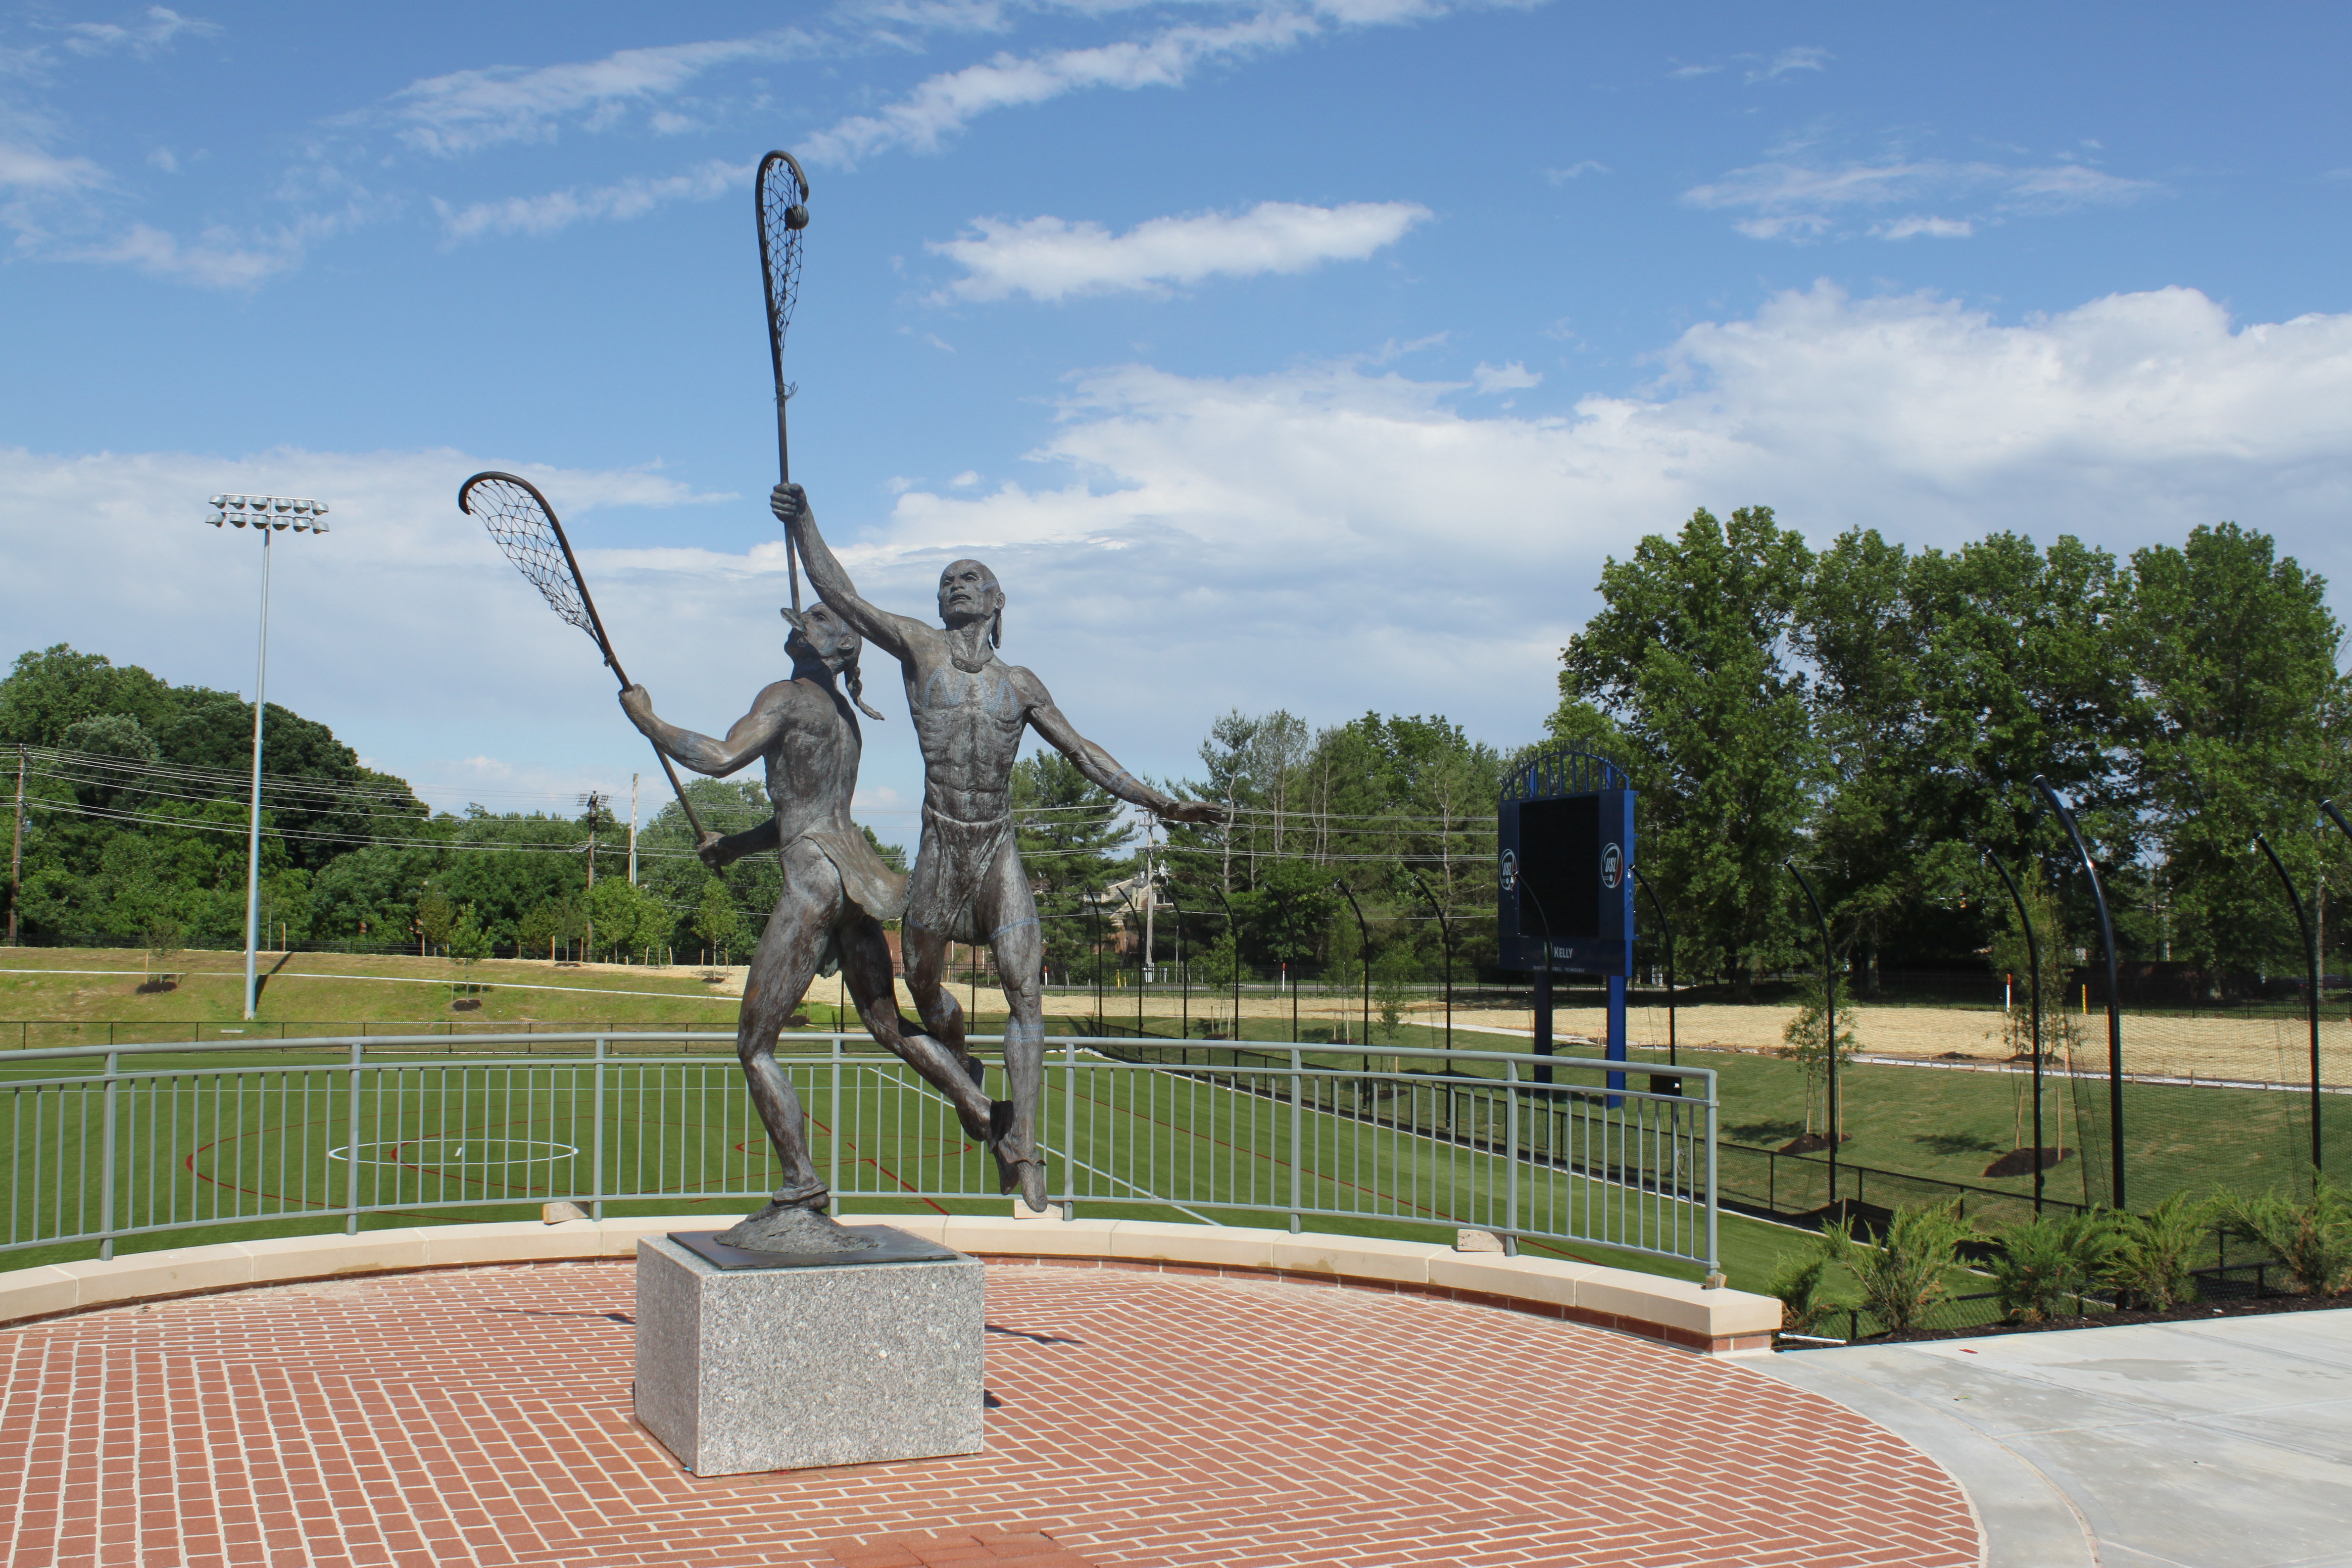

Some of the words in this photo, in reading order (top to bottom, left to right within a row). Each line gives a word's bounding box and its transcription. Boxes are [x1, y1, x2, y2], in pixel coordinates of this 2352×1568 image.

[1503, 862, 1512, 876] USL
[1605, 857, 1617, 872] USL
[1554, 946, 1573, 958] KELLY
